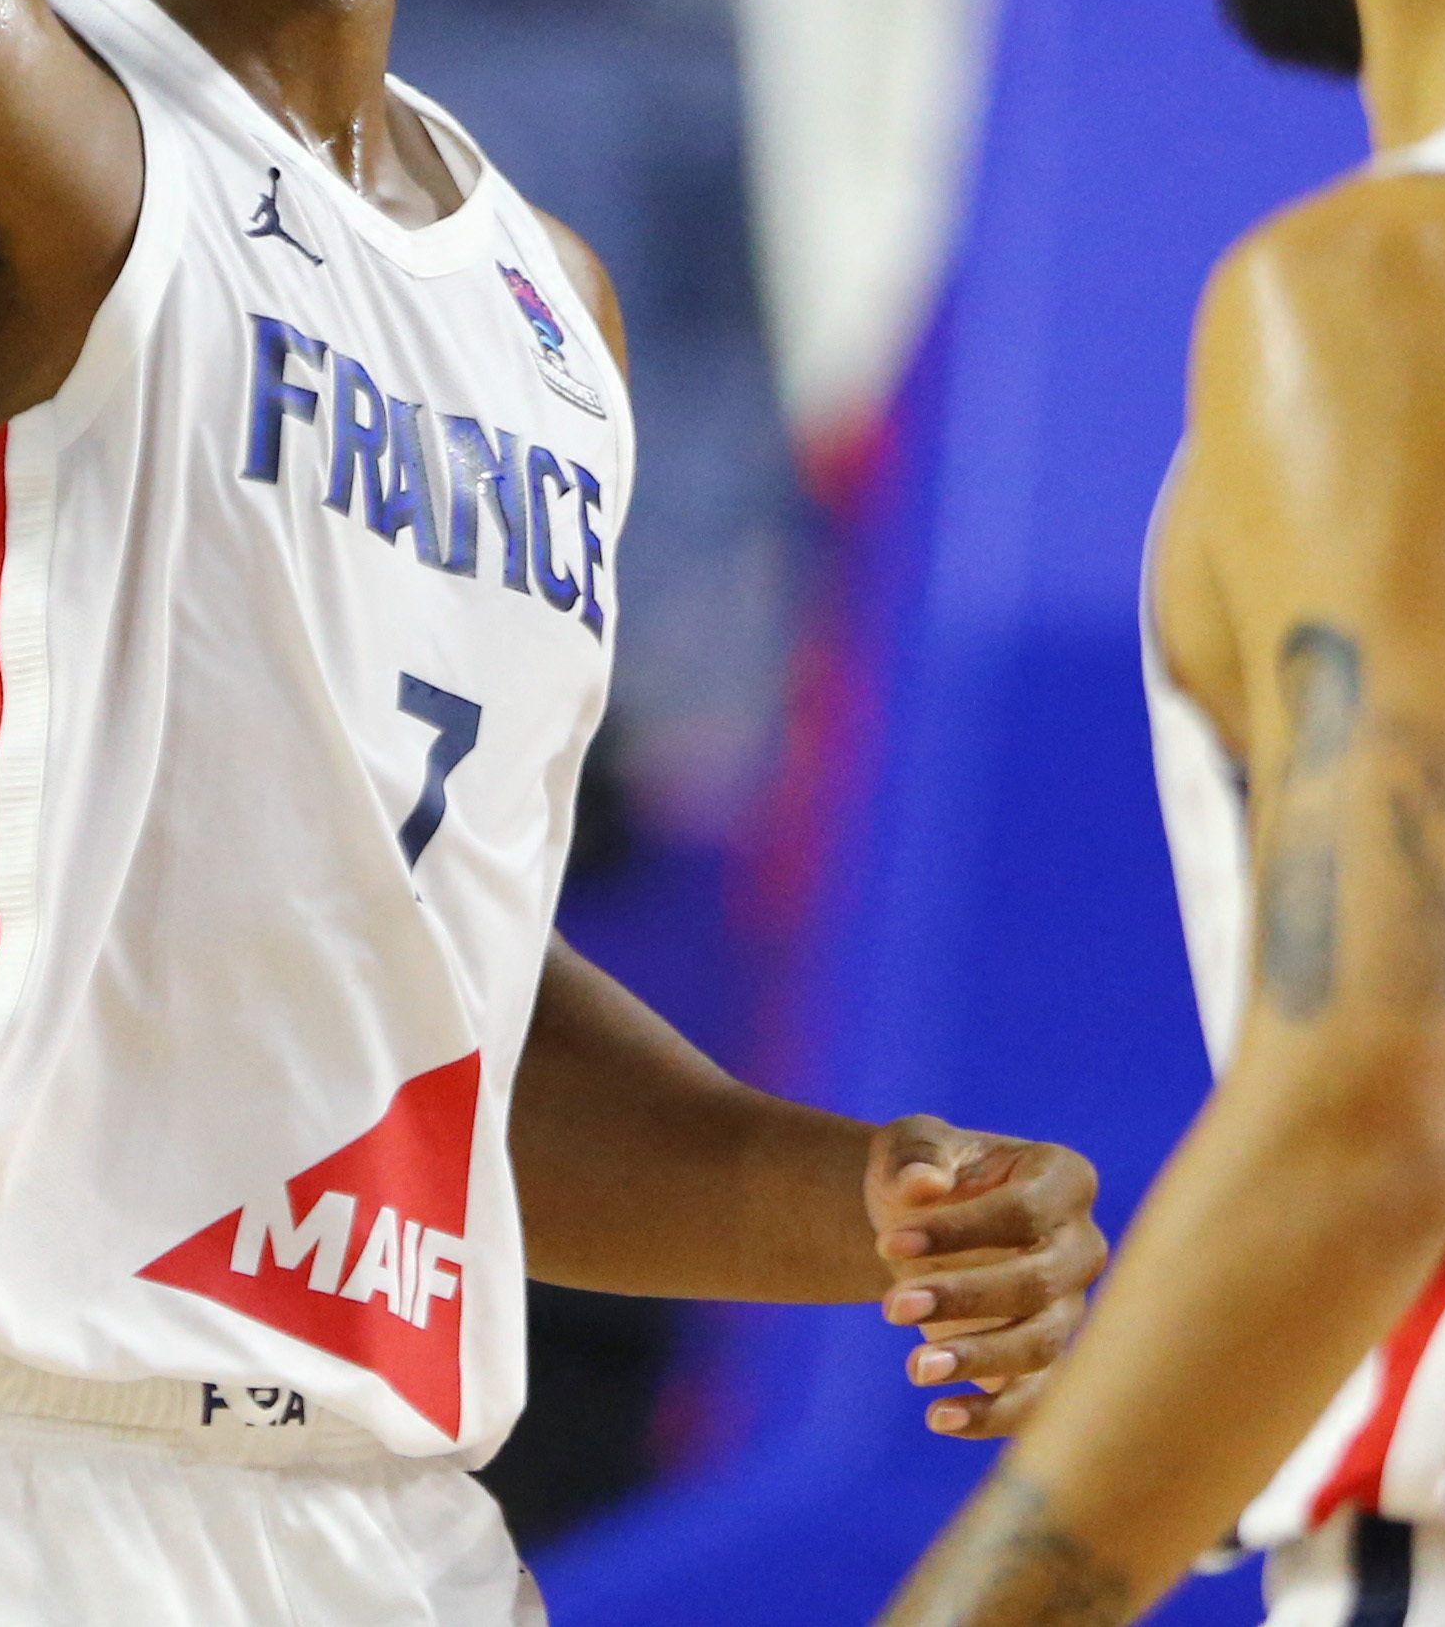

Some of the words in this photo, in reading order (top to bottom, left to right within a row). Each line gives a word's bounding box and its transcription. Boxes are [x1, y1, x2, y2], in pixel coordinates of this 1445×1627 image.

[239, 311, 604, 644] FRANCE
[396, 670, 482, 875] 7
[230, 1181, 466, 1330] MAIF
